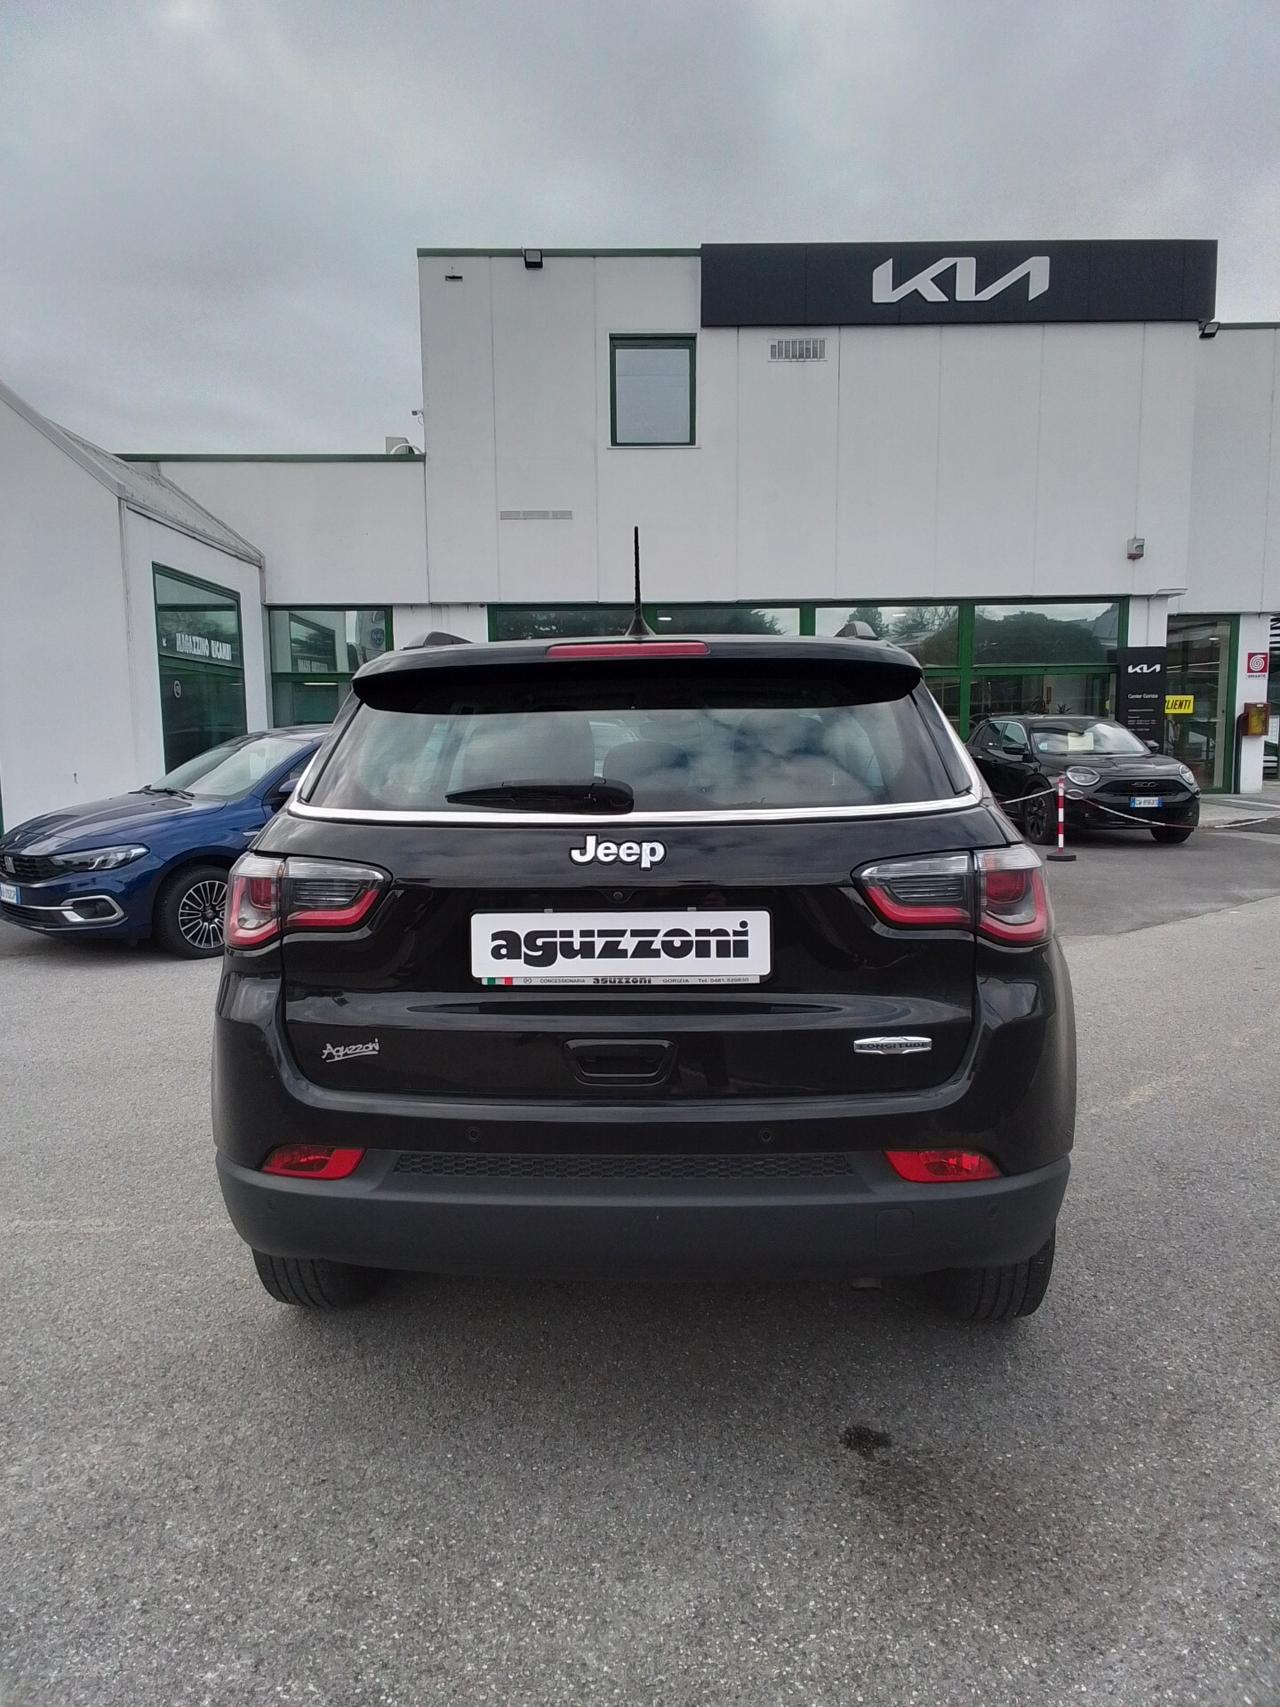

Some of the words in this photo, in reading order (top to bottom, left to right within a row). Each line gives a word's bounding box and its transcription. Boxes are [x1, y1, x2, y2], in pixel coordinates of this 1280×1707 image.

[872, 256, 1050, 303] KIA
[1127, 664, 1161, 674] KIA
[1165, 699, 1192, 710] LIENTI
[570, 835, 665, 868] Jeep
[490, 920, 749, 967] aguzzoni
[592, 976, 652, 984] aguzzoni
